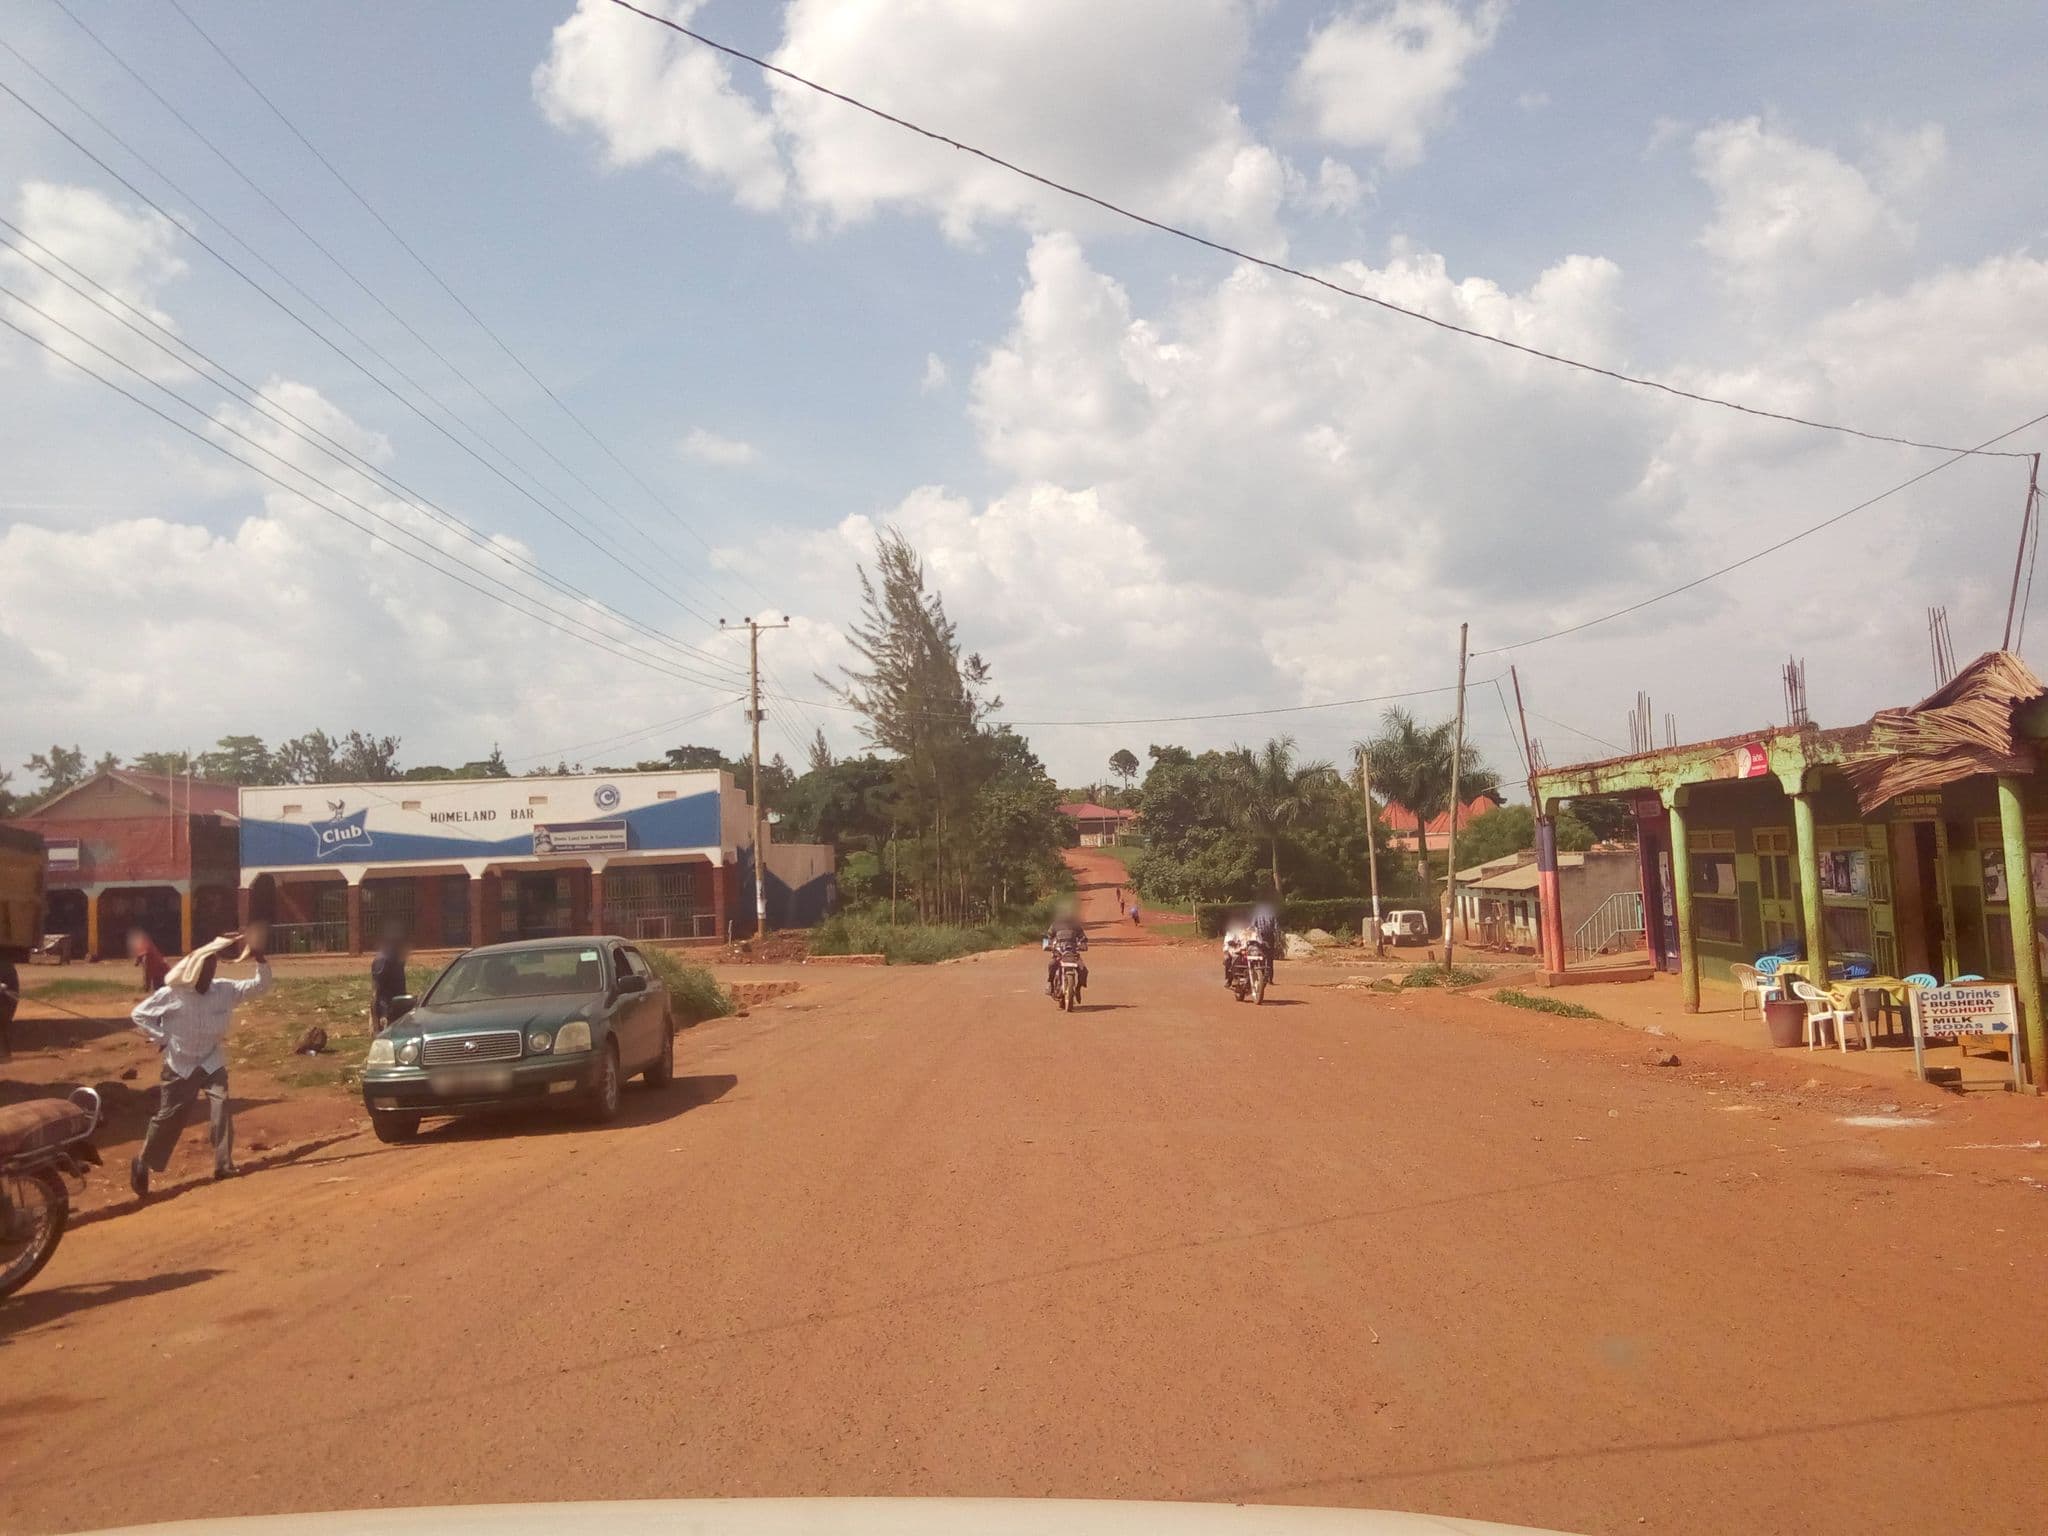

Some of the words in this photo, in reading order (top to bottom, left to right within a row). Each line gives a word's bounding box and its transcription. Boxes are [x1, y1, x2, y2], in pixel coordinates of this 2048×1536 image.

[430, 810, 497, 823] HOMELAND
[511, 809, 534, 820] BAR
[322, 825, 362, 843] Club
[1920, 990, 1951, 1000] Cold
[1956, 989, 2001, 1000] Drinks
[1930, 999, 1994, 1008] BUSHERA
[1931, 1006, 1995, 1015] YOGHURT
[1933, 1016, 1973, 1024] MILK
[1933, 1023, 1984, 1031] SODAS
[1934, 1029, 1984, 1037] WATER
